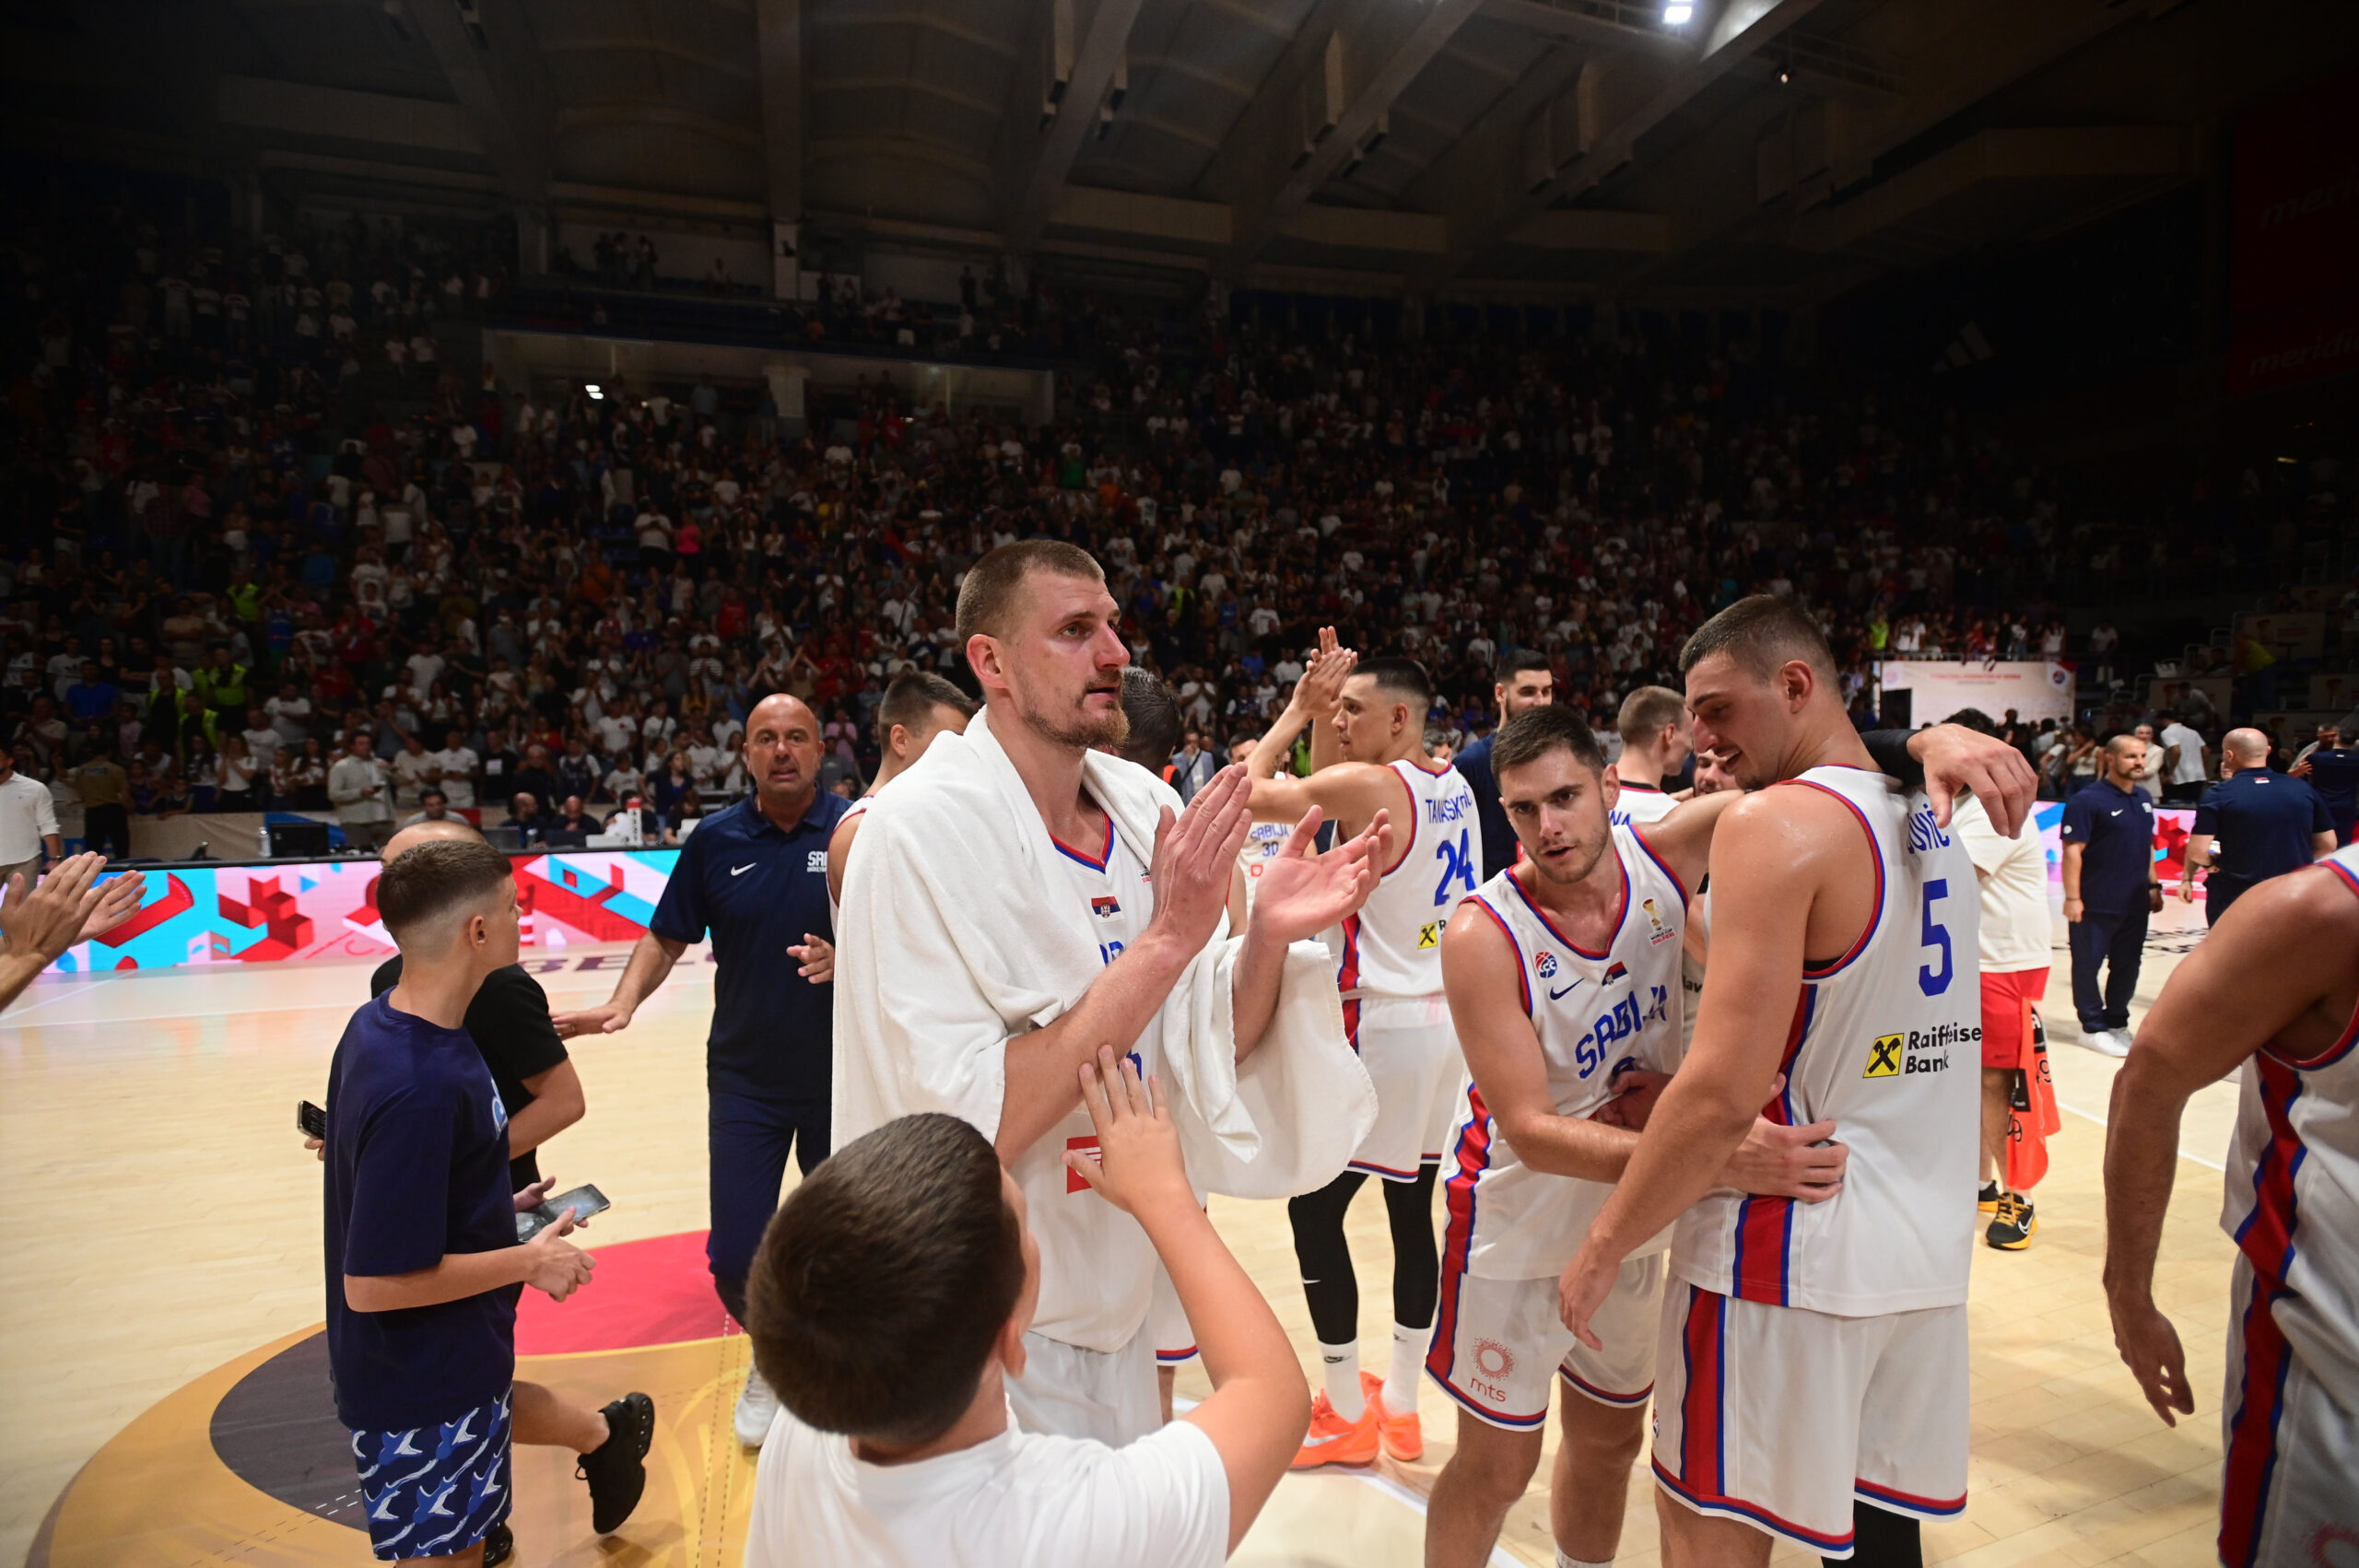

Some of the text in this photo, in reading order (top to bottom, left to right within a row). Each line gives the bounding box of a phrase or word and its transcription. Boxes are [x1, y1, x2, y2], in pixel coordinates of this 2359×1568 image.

[1262, 841, 1279, 857] 30
[1435, 827, 1476, 906] 24
[1919, 878, 1954, 997] 5
[1905, 1049, 1950, 1074] Bank
[1470, 1377, 1507, 1402] mts
